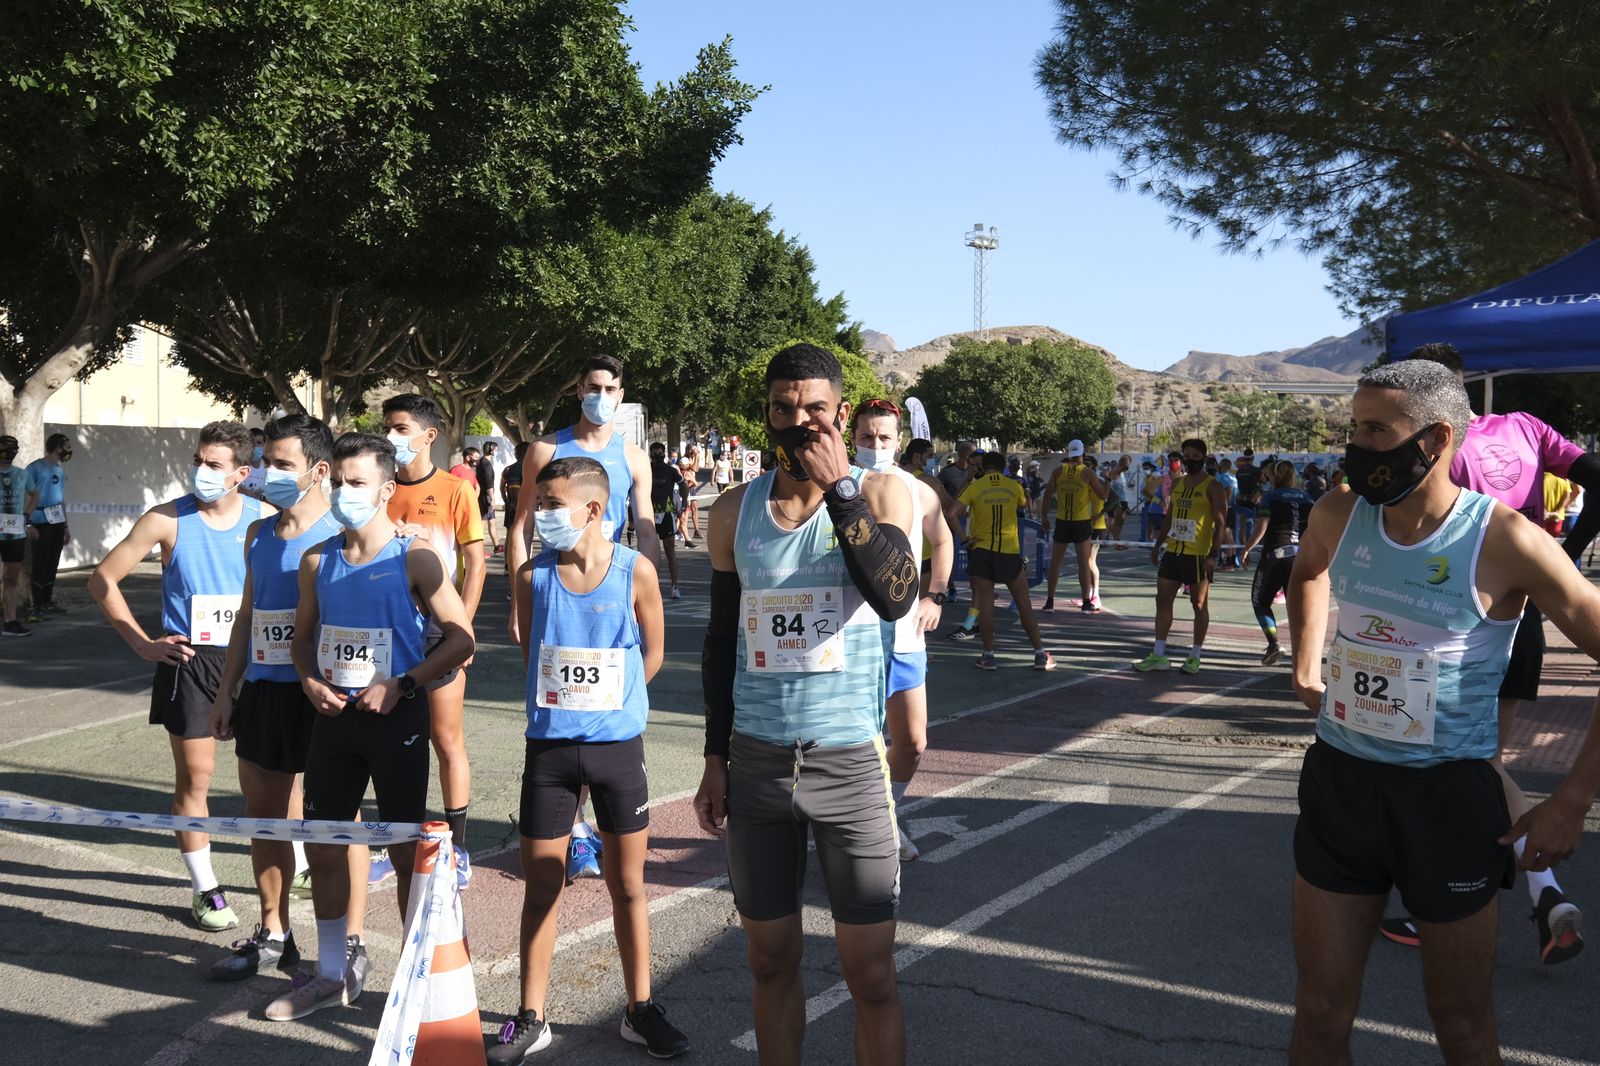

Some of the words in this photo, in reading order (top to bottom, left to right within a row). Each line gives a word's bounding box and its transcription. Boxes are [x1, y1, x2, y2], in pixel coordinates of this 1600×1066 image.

[762, 595, 793, 605] CIRCUITO
[794, 593, 814, 605] 2020
[1354, 580, 1413, 605] Ayuntamiento
[1416, 597, 1429, 609] de
[263, 625, 295, 641] 192
[771, 613, 805, 637] 84
[334, 643, 368, 661] 194
[777, 638, 807, 650] AHMED
[559, 650, 584, 660] CIRCUITO
[1347, 648, 1378, 665] CIRCUITO
[1379, 655, 1402, 669] 2020
[334, 661, 368, 670] FRANCISCO
[560, 665, 600, 684] 193
[569, 685, 590, 694] DAVID
[1353, 671, 1389, 701] 82
[1354, 697, 1394, 717] ZOUHAIR
